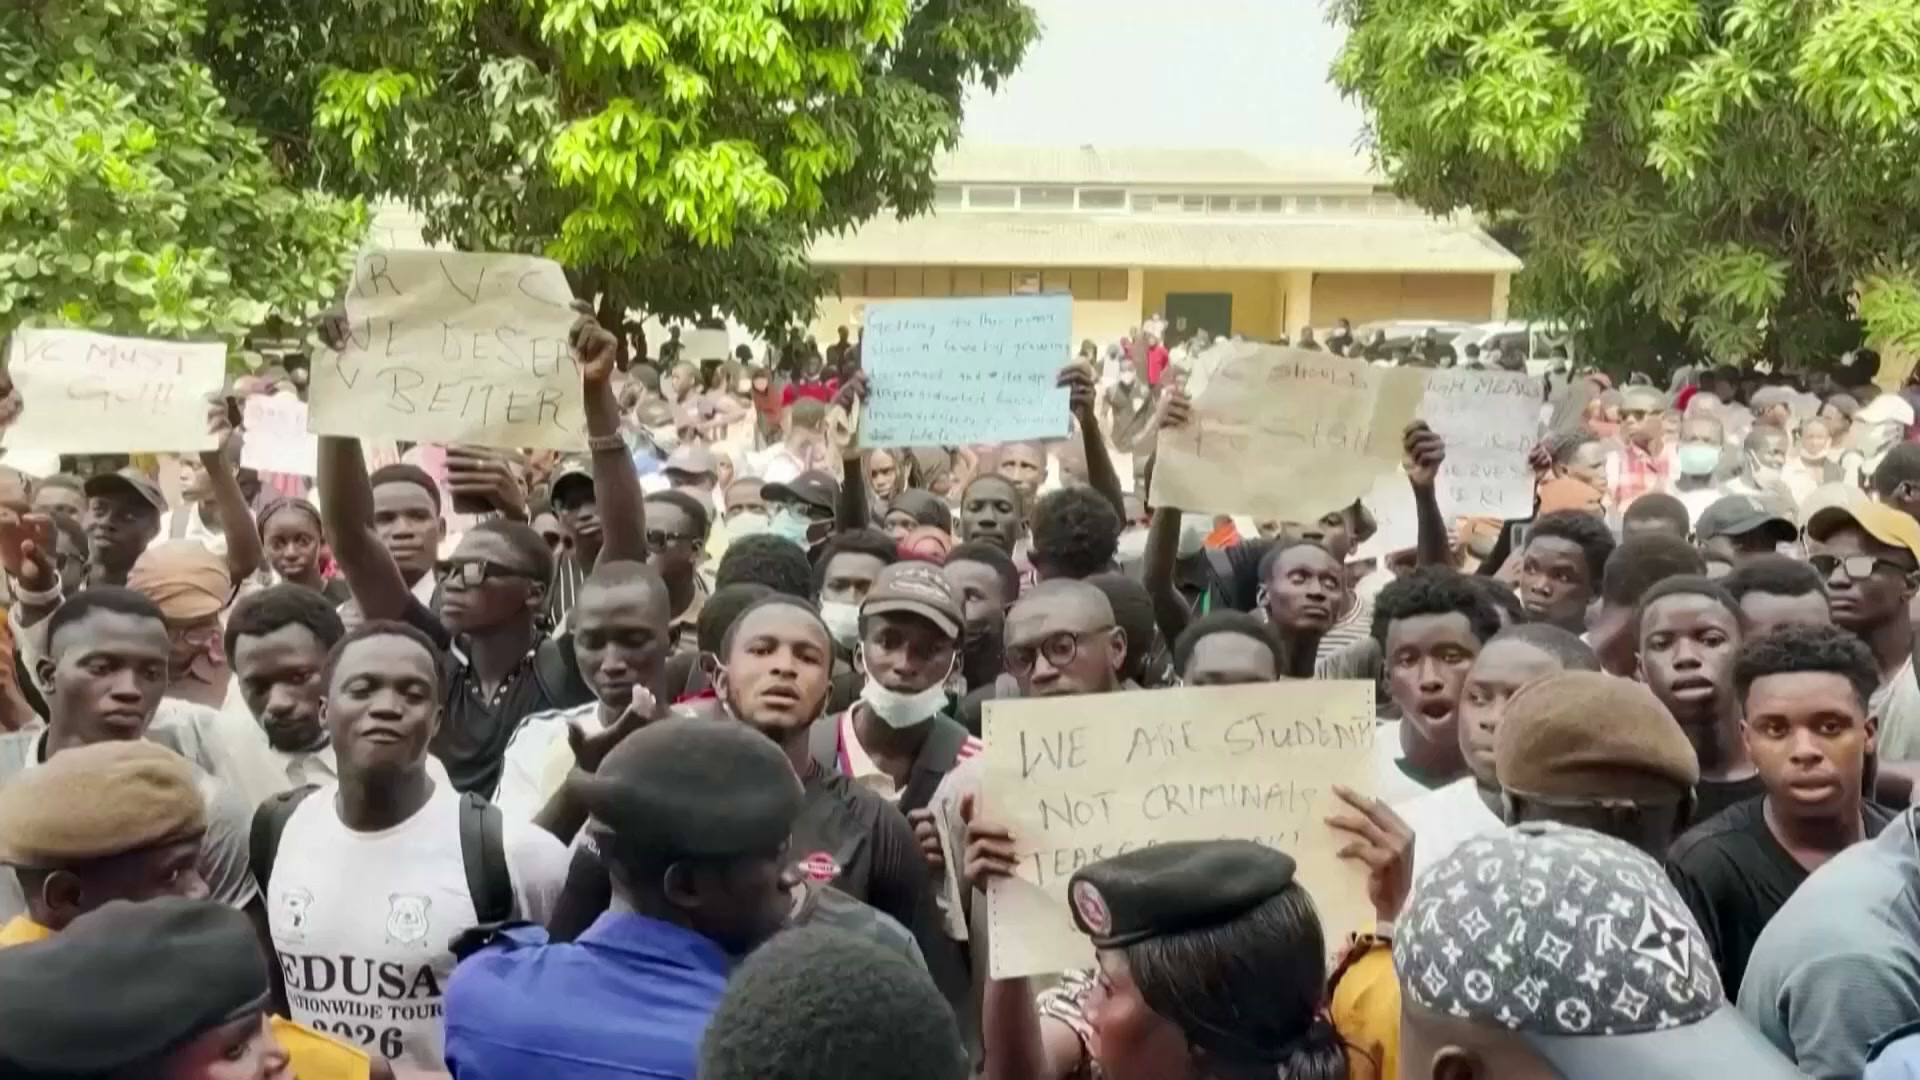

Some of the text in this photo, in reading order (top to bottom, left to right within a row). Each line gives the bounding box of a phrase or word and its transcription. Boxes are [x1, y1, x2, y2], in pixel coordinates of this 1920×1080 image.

[355, 253, 403, 297] R
[375, 365, 569, 433] BETTER
[1018, 726, 1089, 780] WE
[1126, 719, 1202, 764] ARE
[1037, 788, 1119, 831] NOT
[277, 949, 443, 1000] EDUSA
